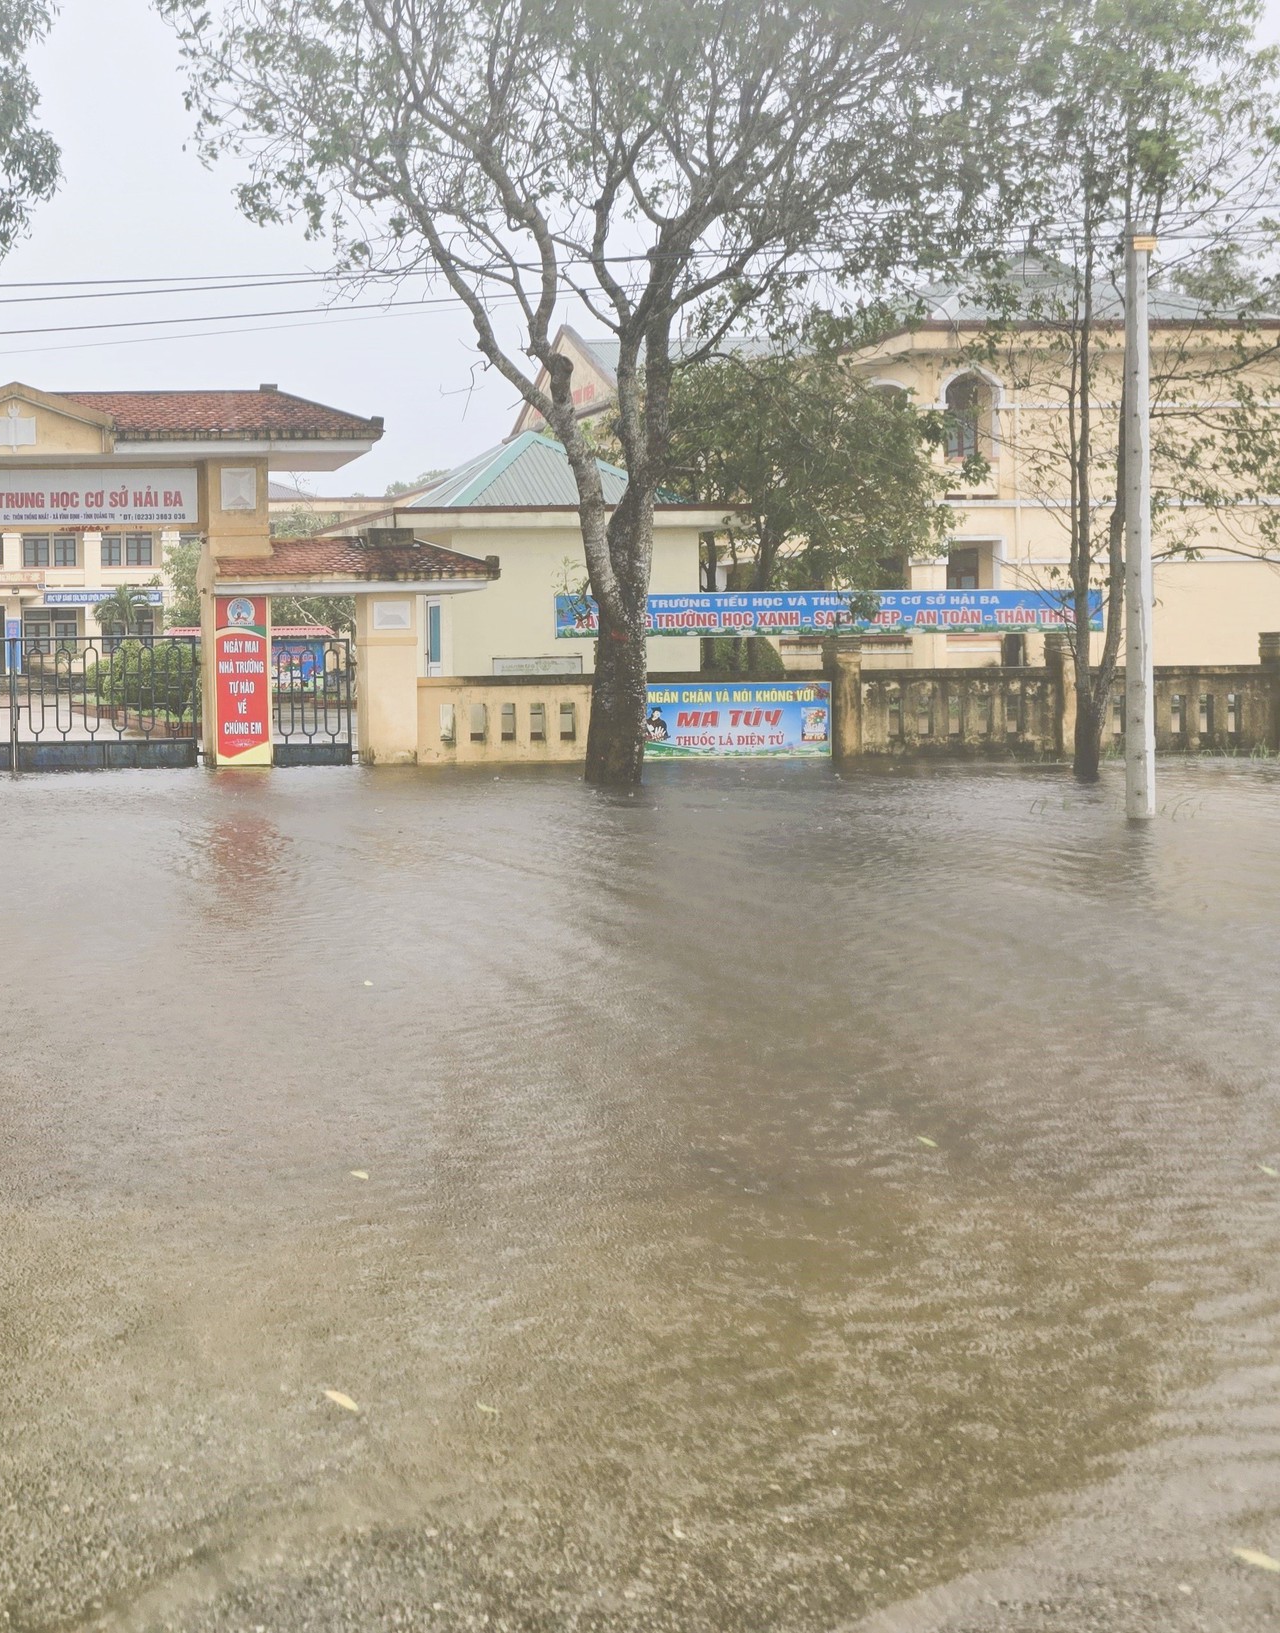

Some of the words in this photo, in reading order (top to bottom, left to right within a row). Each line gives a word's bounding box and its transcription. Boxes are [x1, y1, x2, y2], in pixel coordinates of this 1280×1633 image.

[50, 491, 79, 511] HỌC
[84, 490, 105, 508] CƠ
[108, 485, 129, 508] SỞ
[133, 485, 158, 507] HẢI
[163, 491, 183, 507] BA
[651, 597, 711, 608] TRƯỜNG
[715, 595, 748, 607] TIỂU
[752, 597, 783, 608] HỌC
[787, 595, 807, 606] VÀ
[900, 595, 921, 605] CƠ
[926, 594, 946, 605] SỞ
[950, 594, 975, 605] HẢI
[980, 595, 1000, 604] BA
[656, 609, 718, 627] TRƯỜNG
[722, 612, 754, 629] HỌC
[758, 612, 799, 626] XANH
[915, 610, 937, 624] AN
[942, 606, 981, 624] TOÀN
[996, 606, 1035, 623] THÂN
[223, 638, 243, 653] NGÀY
[244, 640, 259, 653] MAI
[219, 659, 234, 674] NHÀ
[235, 659, 265, 674] TRƯỜNG
[229, 681, 240, 697] TỰ
[240, 679, 255, 694] HÀO
[647, 688, 678, 703] NGĂN
[682, 688, 712, 705] CHẶN
[716, 688, 730, 702] VÀ
[733, 688, 751, 702] NÓI
[755, 688, 793, 702] KHÔNG
[796, 688, 814, 701] VỚI
[224, 720, 249, 735] CHÚNG
[250, 722, 262, 735] EM
[676, 710, 719, 728] MA
[676, 732, 715, 746] THUỐC
[718, 732, 733, 746] LÁ
[737, 733, 765, 748] ĐIỆN
[768, 731, 784, 745] TỬ
